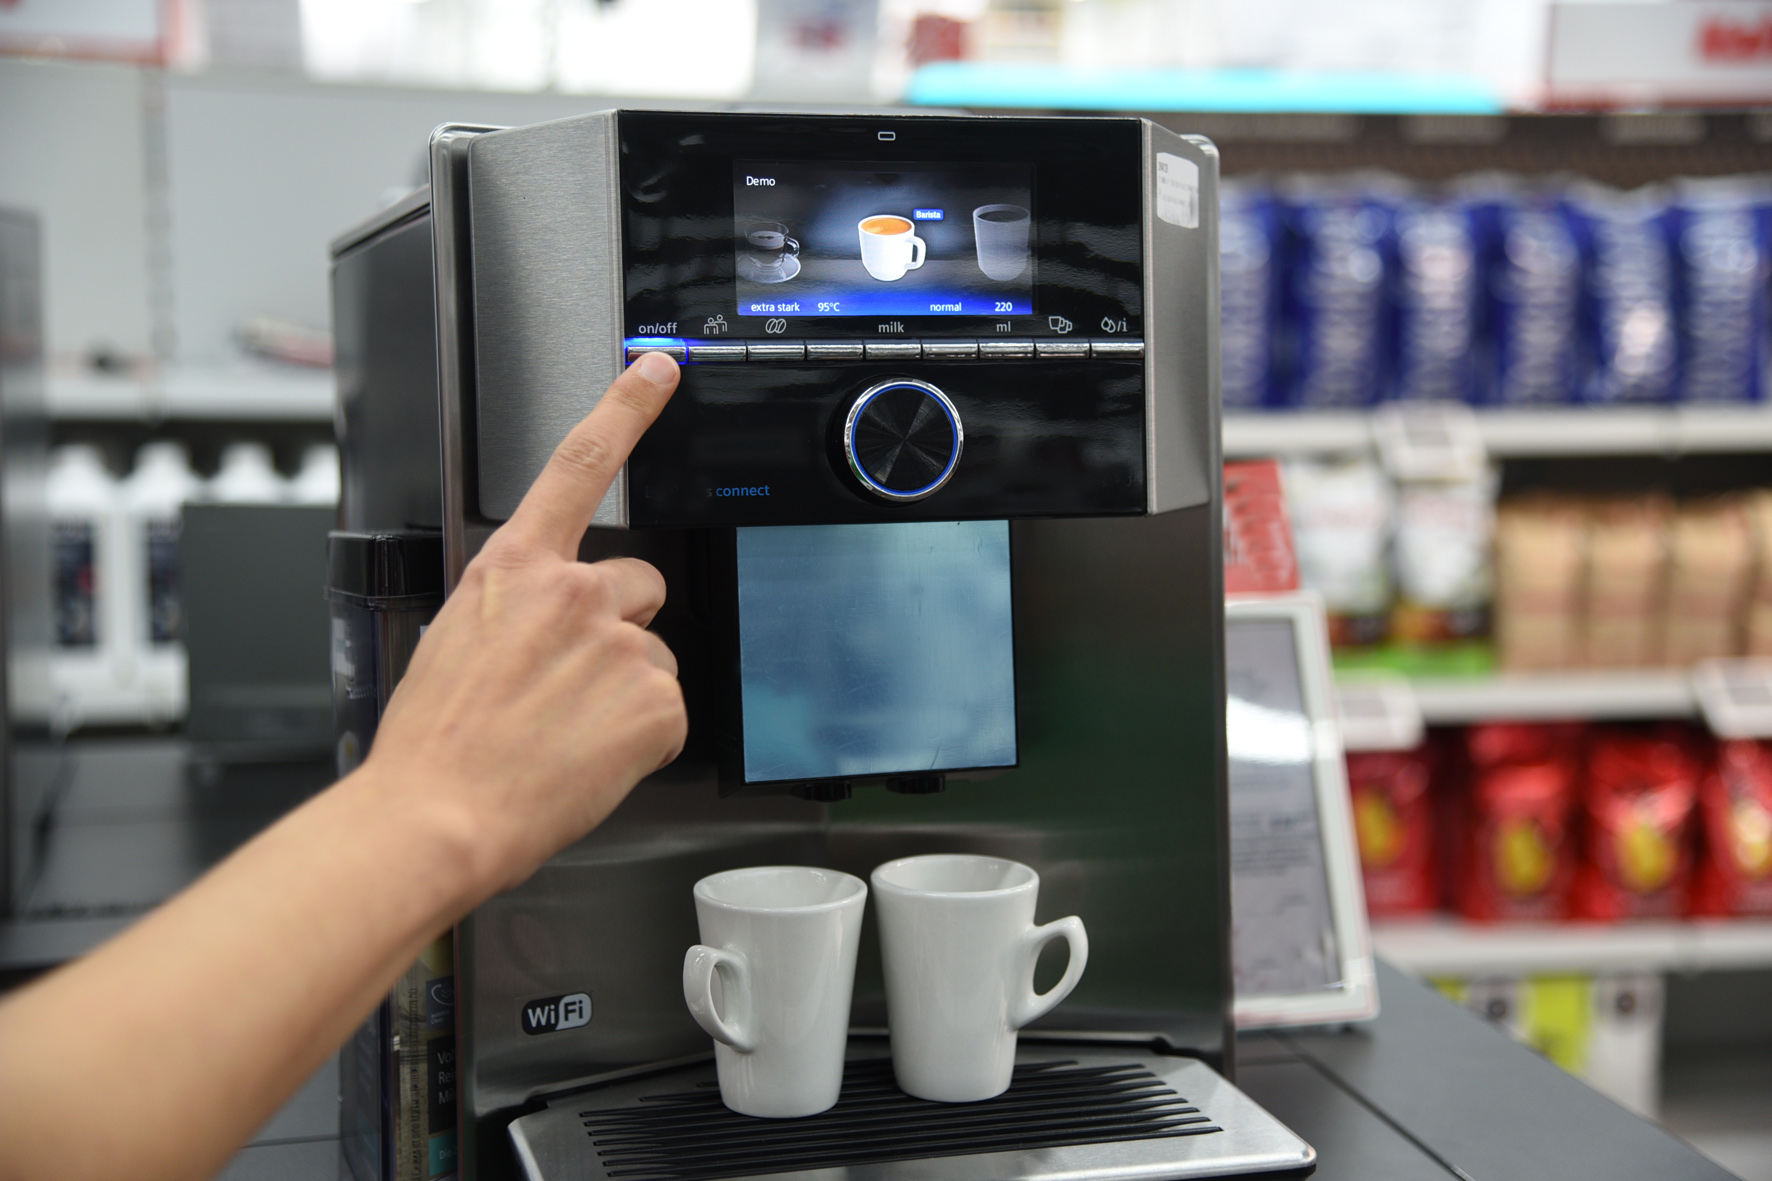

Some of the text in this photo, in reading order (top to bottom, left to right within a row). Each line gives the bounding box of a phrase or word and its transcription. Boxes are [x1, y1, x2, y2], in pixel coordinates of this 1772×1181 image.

[746, 176, 776, 187] Demo
[915, 210, 941, 219] Barista
[751, 302, 800, 312] extra stark
[817, 302, 840, 312] 95°C
[930, 302, 962, 312] normal
[994, 302, 1013, 312] 220
[638, 322, 678, 335] on/off
[878, 321, 905, 333] milk
[996, 321, 1011, 332] ml
[716, 485, 770, 497] connect
[527, 1000, 584, 1028] WiFi
